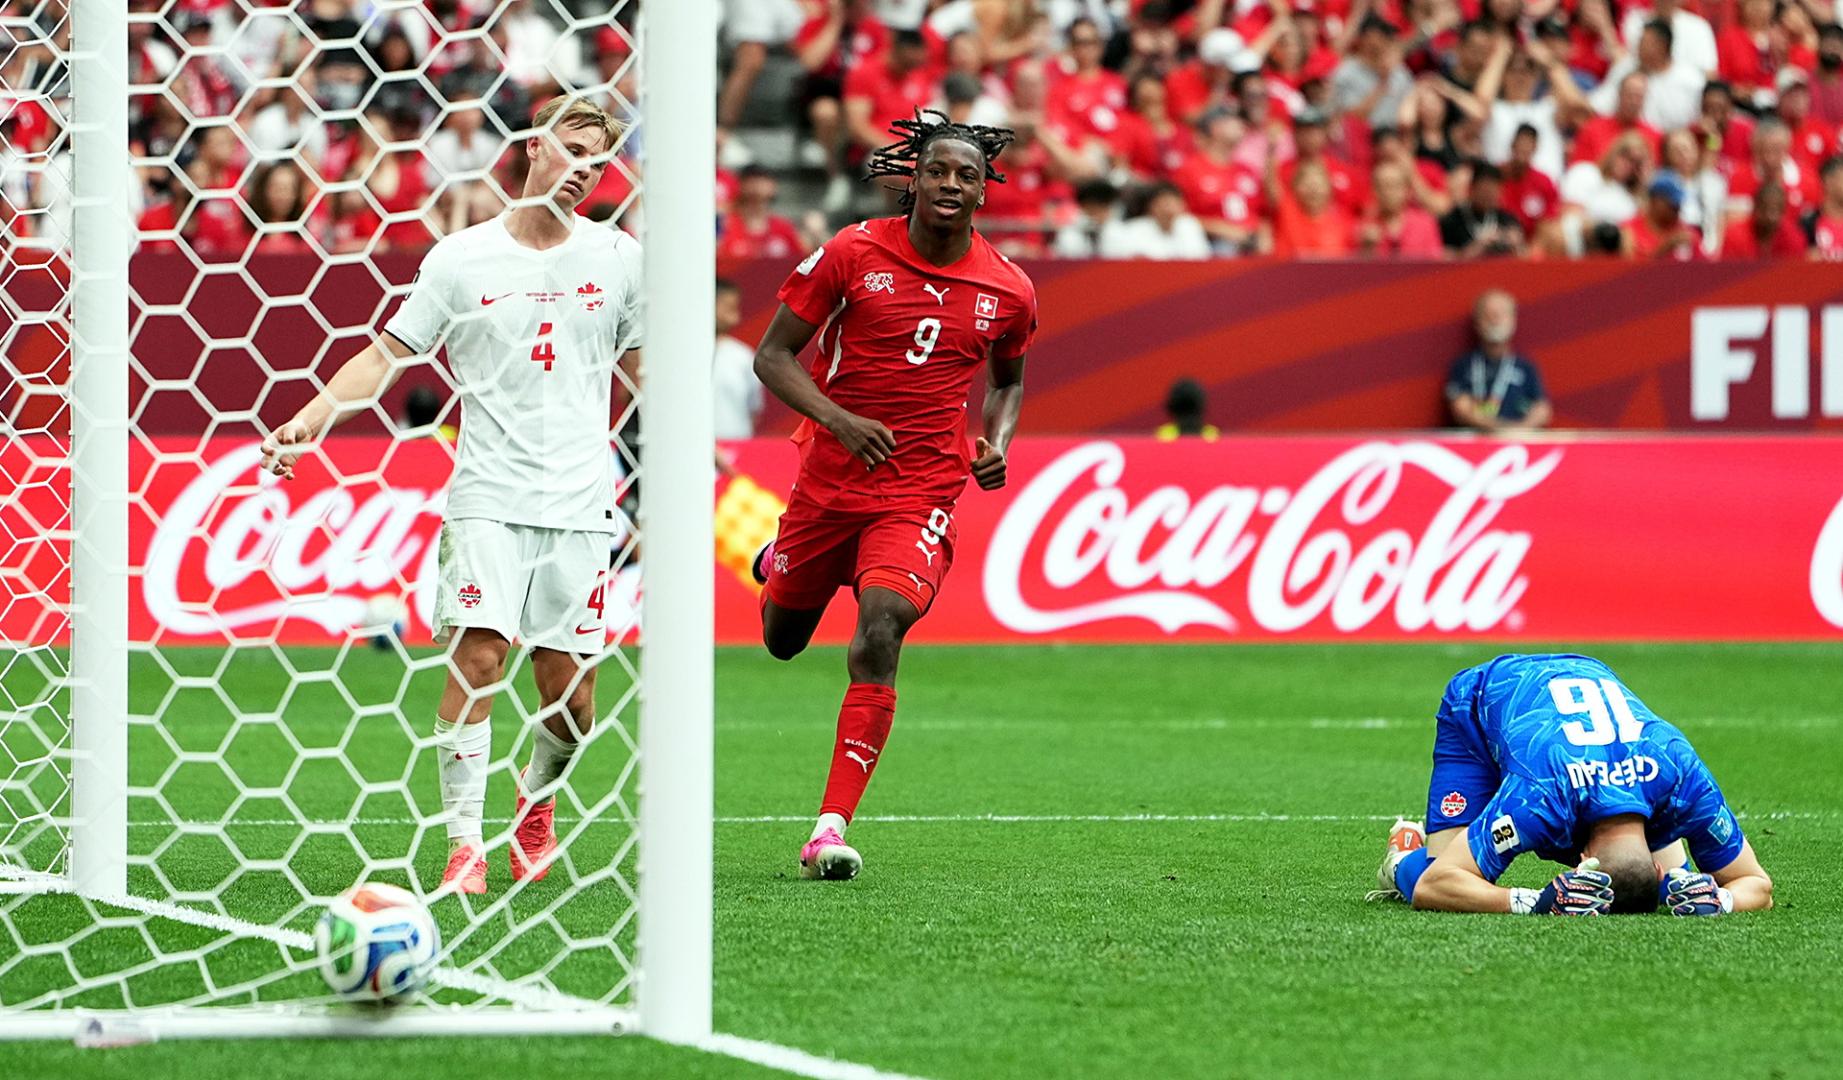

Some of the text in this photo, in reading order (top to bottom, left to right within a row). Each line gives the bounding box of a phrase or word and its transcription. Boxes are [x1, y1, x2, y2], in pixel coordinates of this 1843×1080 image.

[531, 322, 556, 371] 4
[905, 317, 942, 366] 9
[1690, 305, 1843, 421] FI
[921, 507, 949, 545] 9
[982, 440, 1565, 633] Coca-Cola
[587, 571, 605, 620] 4
[1547, 678, 1645, 747] 16
